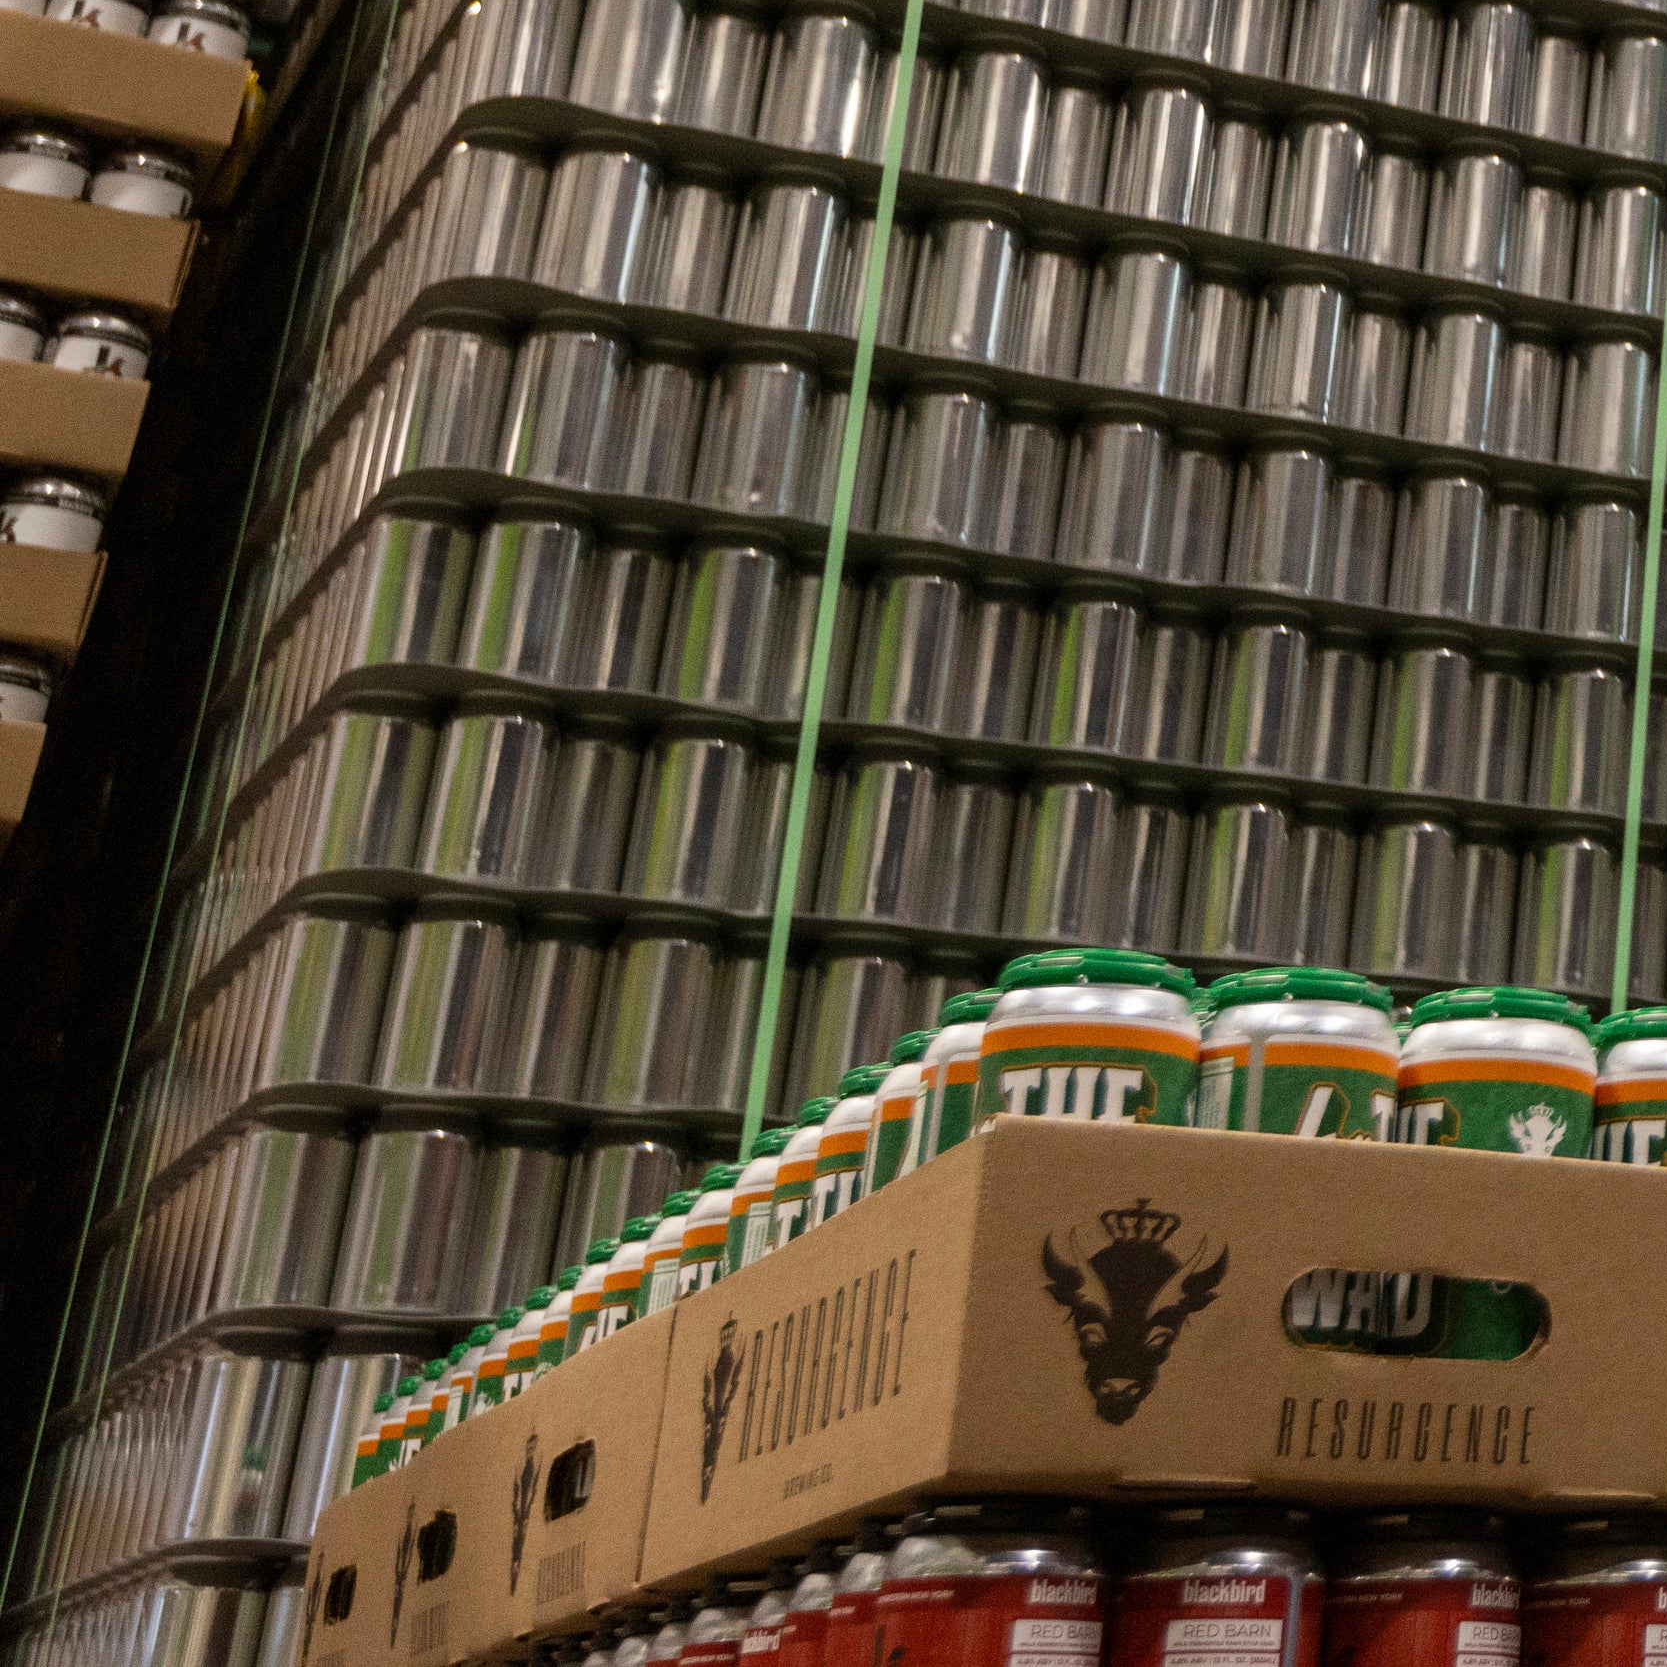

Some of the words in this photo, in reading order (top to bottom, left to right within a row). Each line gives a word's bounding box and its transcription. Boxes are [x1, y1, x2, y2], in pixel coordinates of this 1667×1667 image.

[739, 1248, 917, 1463] RESURGENCE
[1276, 1397, 1535, 1464] RESURGENCE
[1183, 1580, 1267, 1604] blackbird
[1031, 1625, 1063, 1639] RED
[1184, 1624, 1220, 1638] RED
[1225, 1624, 1271, 1638] BARN
[1473, 1626, 1499, 1640] RED
